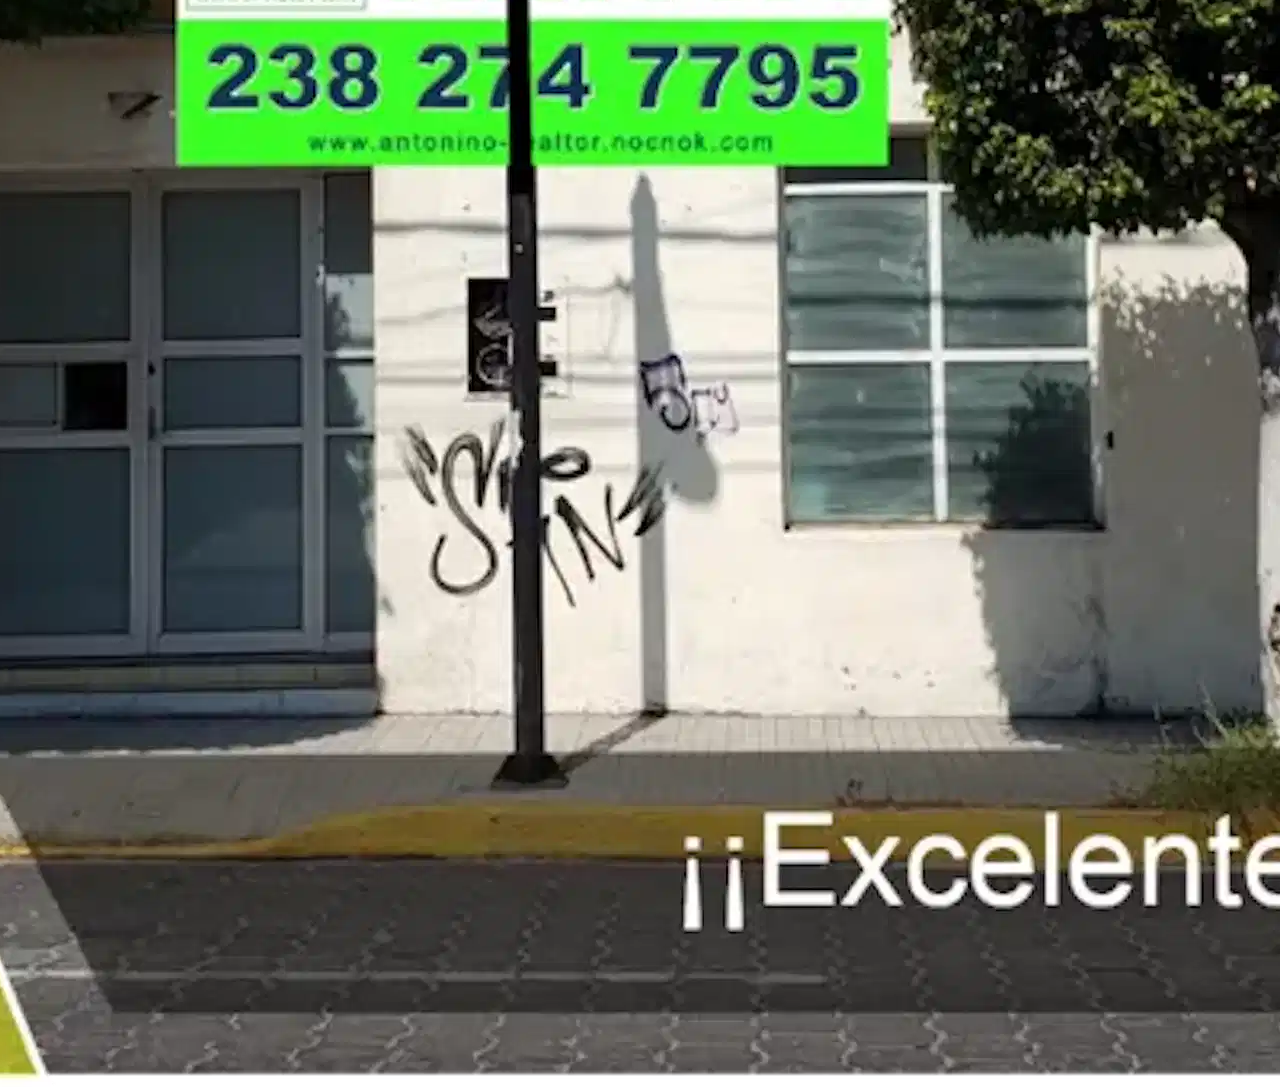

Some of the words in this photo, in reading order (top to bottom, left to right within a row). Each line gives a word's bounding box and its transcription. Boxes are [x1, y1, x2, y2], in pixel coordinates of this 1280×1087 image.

[206, 43, 380, 110] 238
[417, 43, 592, 110] 274
[628, 43, 860, 110] 7795
[308, 131, 773, 154] www.antonino-altor.nocnok.com
